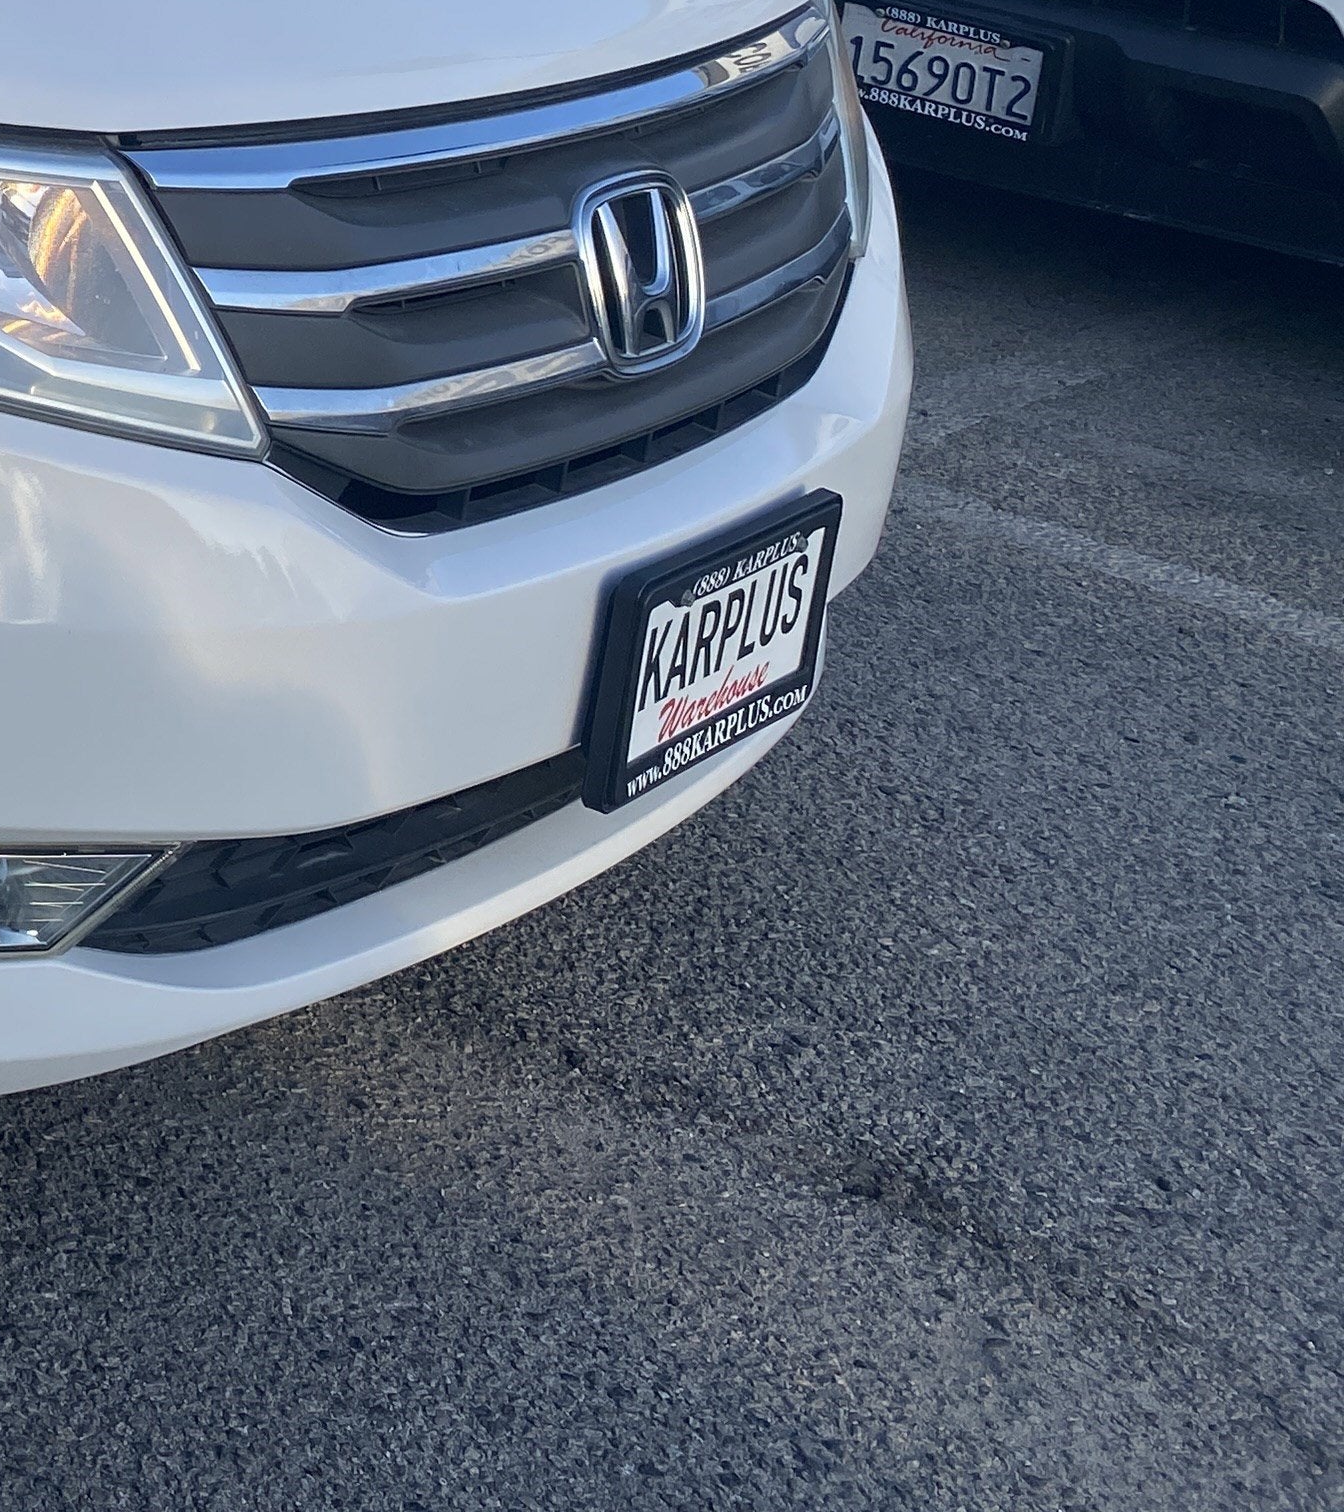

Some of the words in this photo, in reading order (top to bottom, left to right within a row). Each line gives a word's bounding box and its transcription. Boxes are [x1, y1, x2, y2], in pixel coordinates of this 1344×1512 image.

[881, 18, 1011, 63] California
[885, 7, 921, 24] (888)
[926, 16, 1001, 45] KARPLUS
[850, 35, 1032, 121] 15690T2
[692, 567, 731, 597] (888)
[733, 531, 802, 580] KARPLUS
[637, 553, 810, 713] KARPLUS
[657, 660, 771, 743] Warehouse
